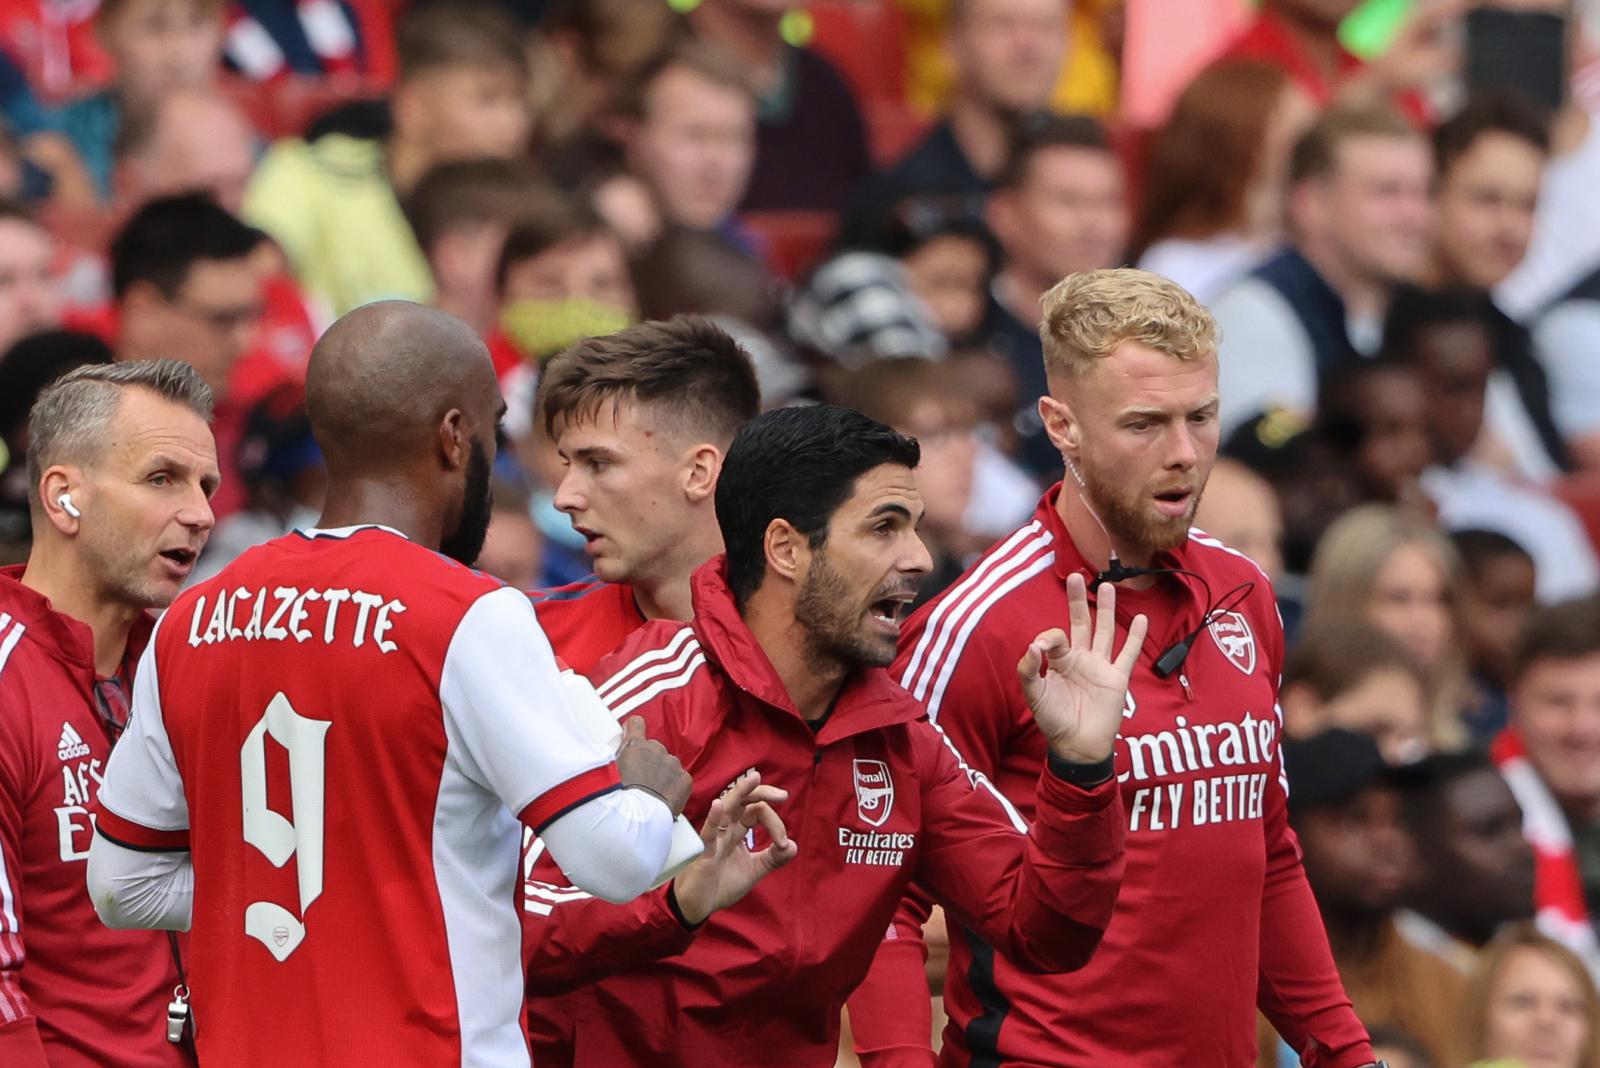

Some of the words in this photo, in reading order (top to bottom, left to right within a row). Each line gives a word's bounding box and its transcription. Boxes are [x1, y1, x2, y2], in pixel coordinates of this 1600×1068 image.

[187, 586, 407, 654] LACAZETTE
[1115, 711, 1276, 784] mirate
[241, 691, 332, 962] 9
[1129, 783, 1183, 832] FLY
[1193, 773, 1267, 826] BETTER
[839, 827, 915, 849] Emirates
[846, 849, 864, 864] FLY
[865, 850, 903, 866] BETTER
